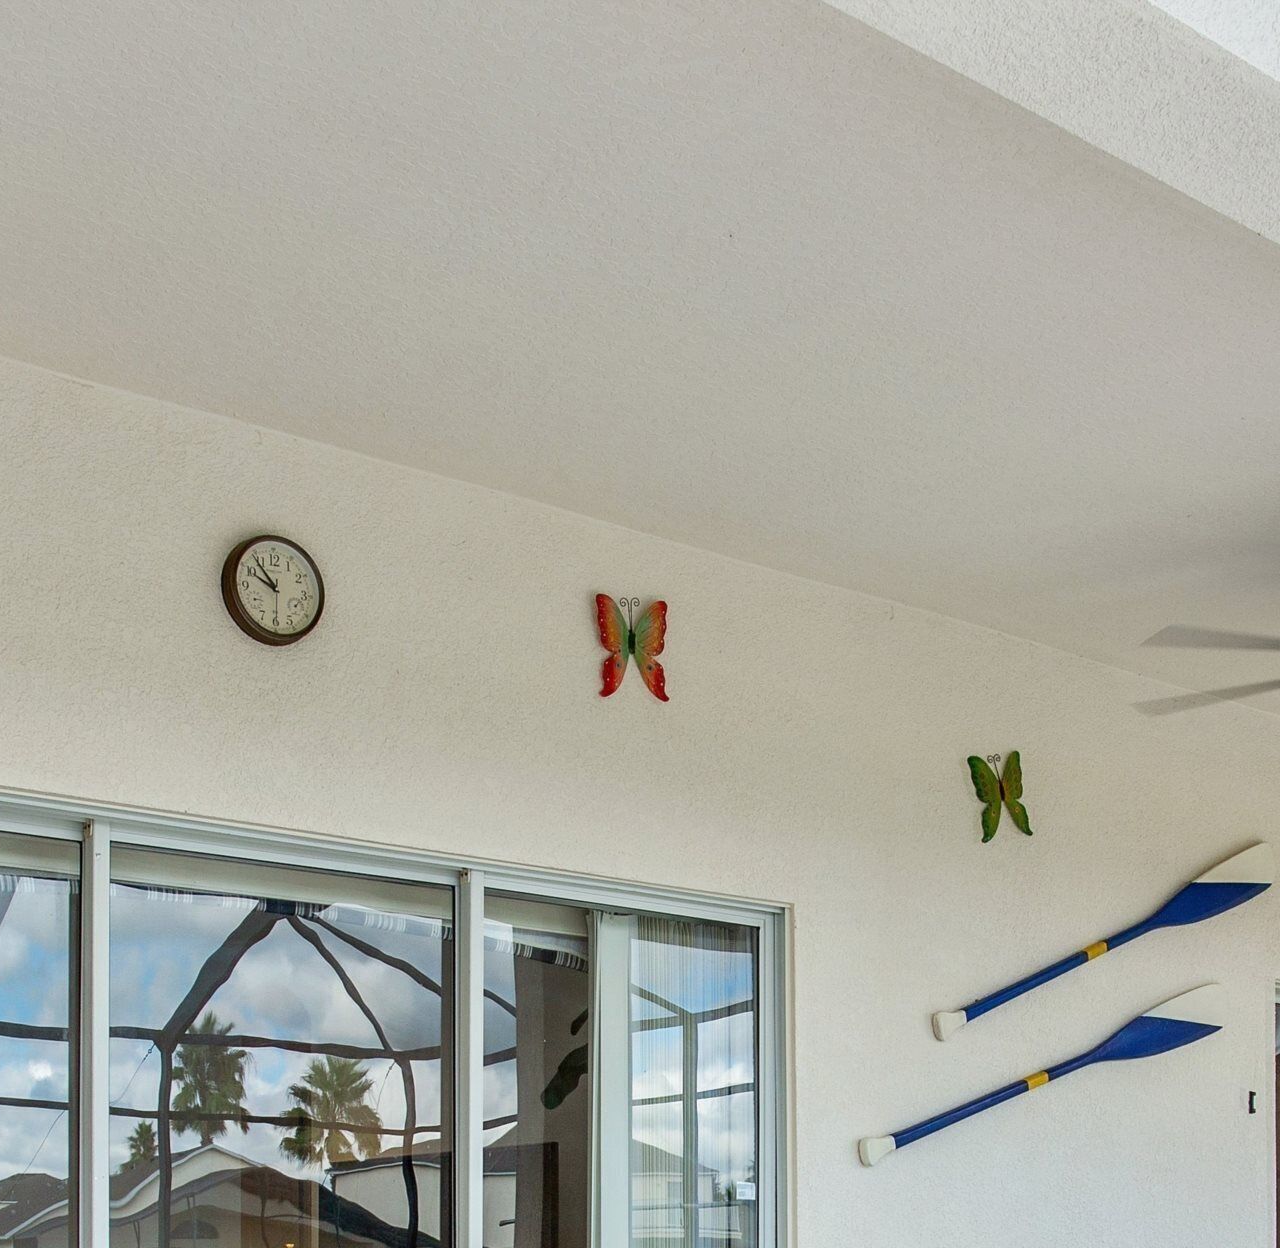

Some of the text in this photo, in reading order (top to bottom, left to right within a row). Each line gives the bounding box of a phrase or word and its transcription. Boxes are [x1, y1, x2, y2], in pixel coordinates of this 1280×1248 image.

[269, 554, 279, 567] 12
[247, 566, 256, 577] 10
[295, 573, 302, 583] 2
[242, 580, 249, 591] 9
[300, 590, 307, 600] 3
[260, 610, 265, 620] 7
[286, 615, 293, 625] 5
[272, 617, 279, 626] 6
